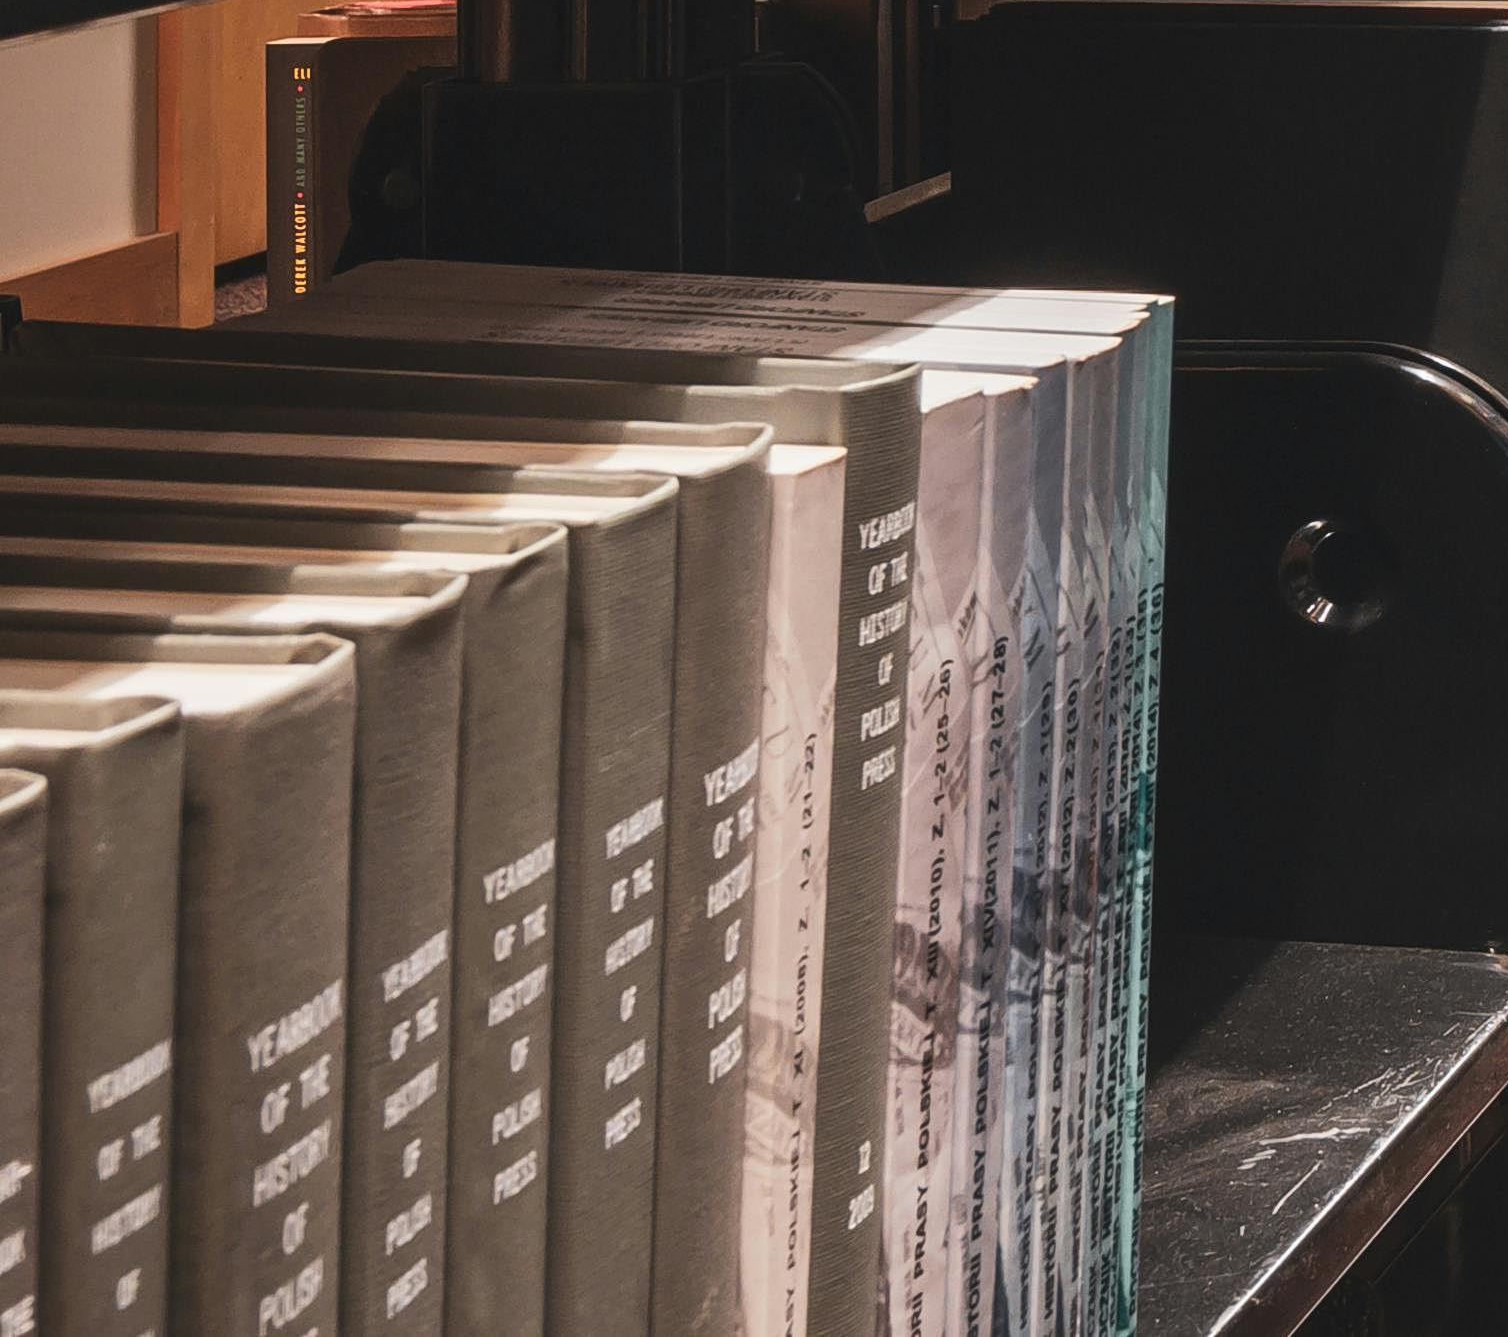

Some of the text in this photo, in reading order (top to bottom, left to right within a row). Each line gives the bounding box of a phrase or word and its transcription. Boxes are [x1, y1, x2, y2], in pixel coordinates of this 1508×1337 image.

[294, 203, 307, 294] DEREK WALCOTT
[494, 924, 517, 962] OF
[510, 1035, 531, 1073] OF
